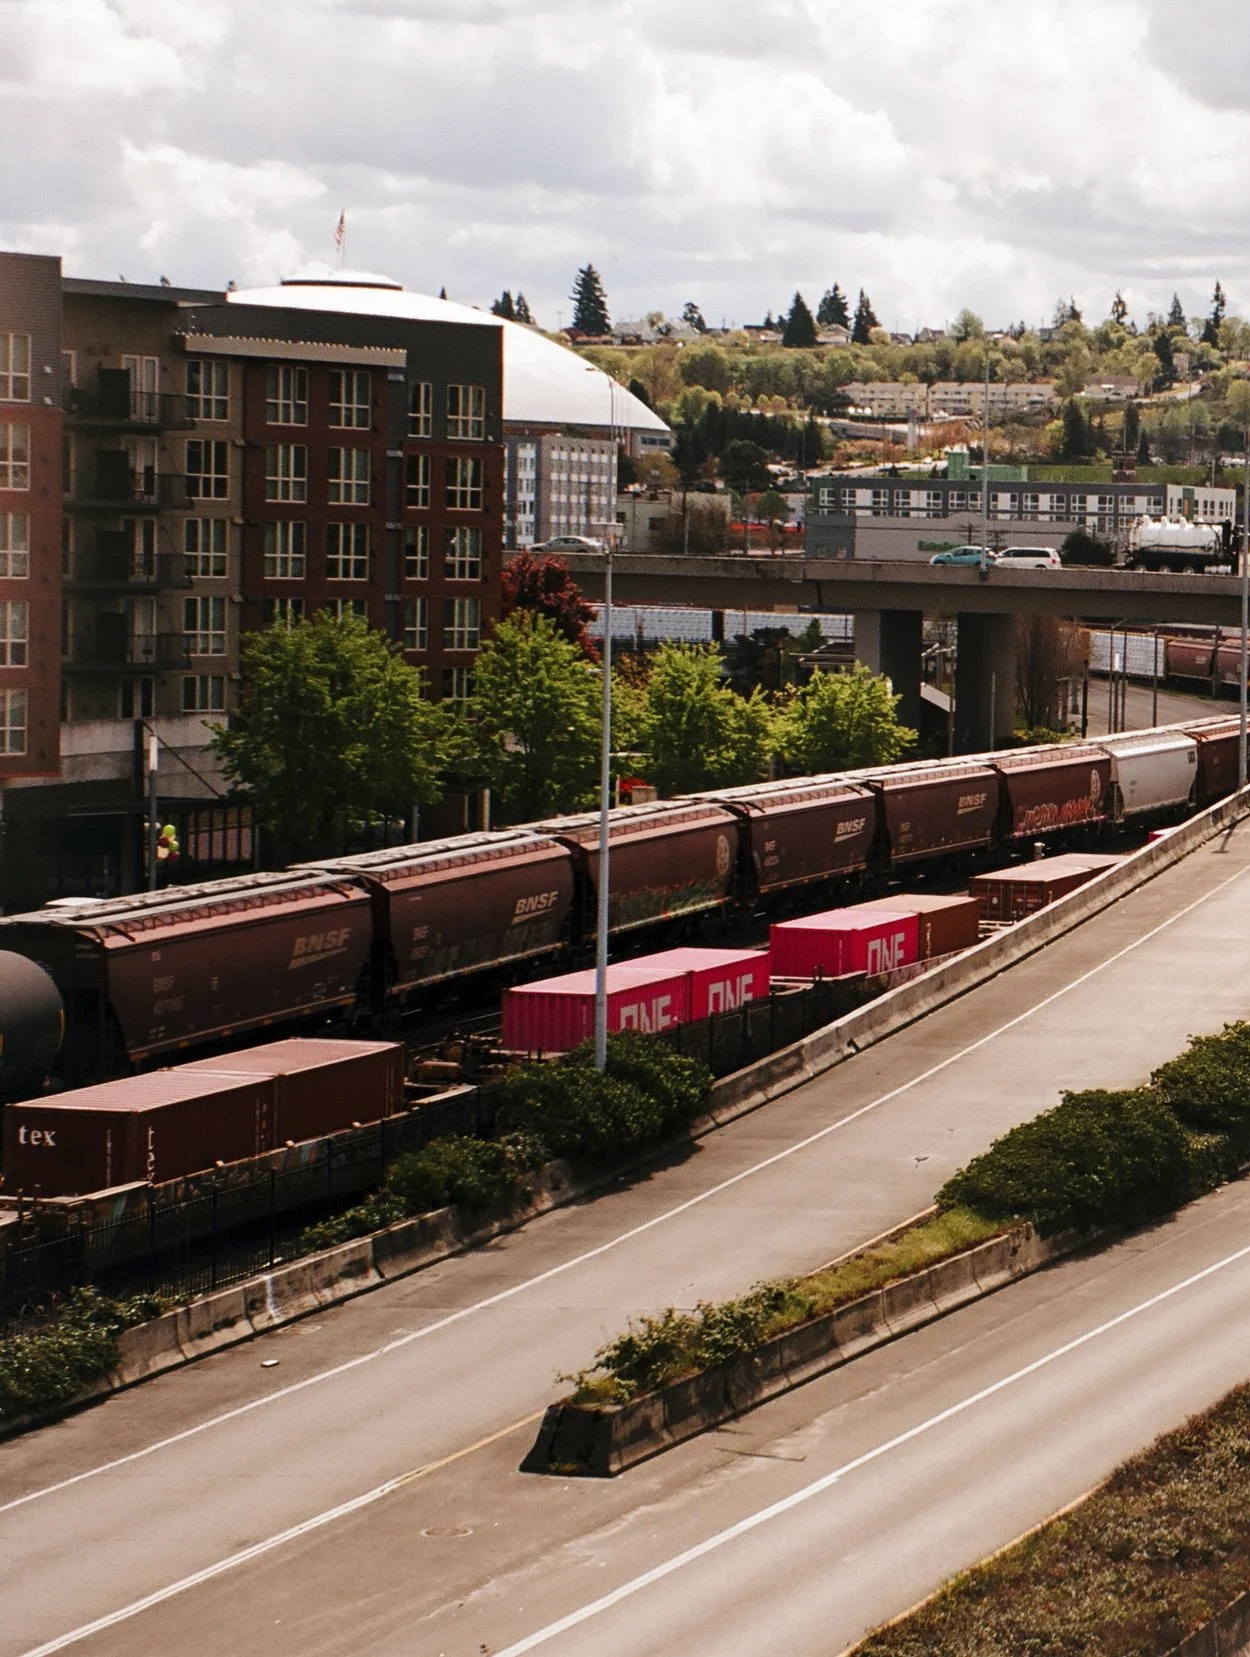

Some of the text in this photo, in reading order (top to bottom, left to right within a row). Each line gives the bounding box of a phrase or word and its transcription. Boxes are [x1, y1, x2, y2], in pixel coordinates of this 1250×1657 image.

[957, 793, 987, 808] BNSF
[836, 817, 867, 835] BNSF
[515, 890, 560, 914] BNSF
[291, 927, 351, 958] BNSF
[867, 932, 906, 977] ONE
[18, 1124, 57, 1147] tex
